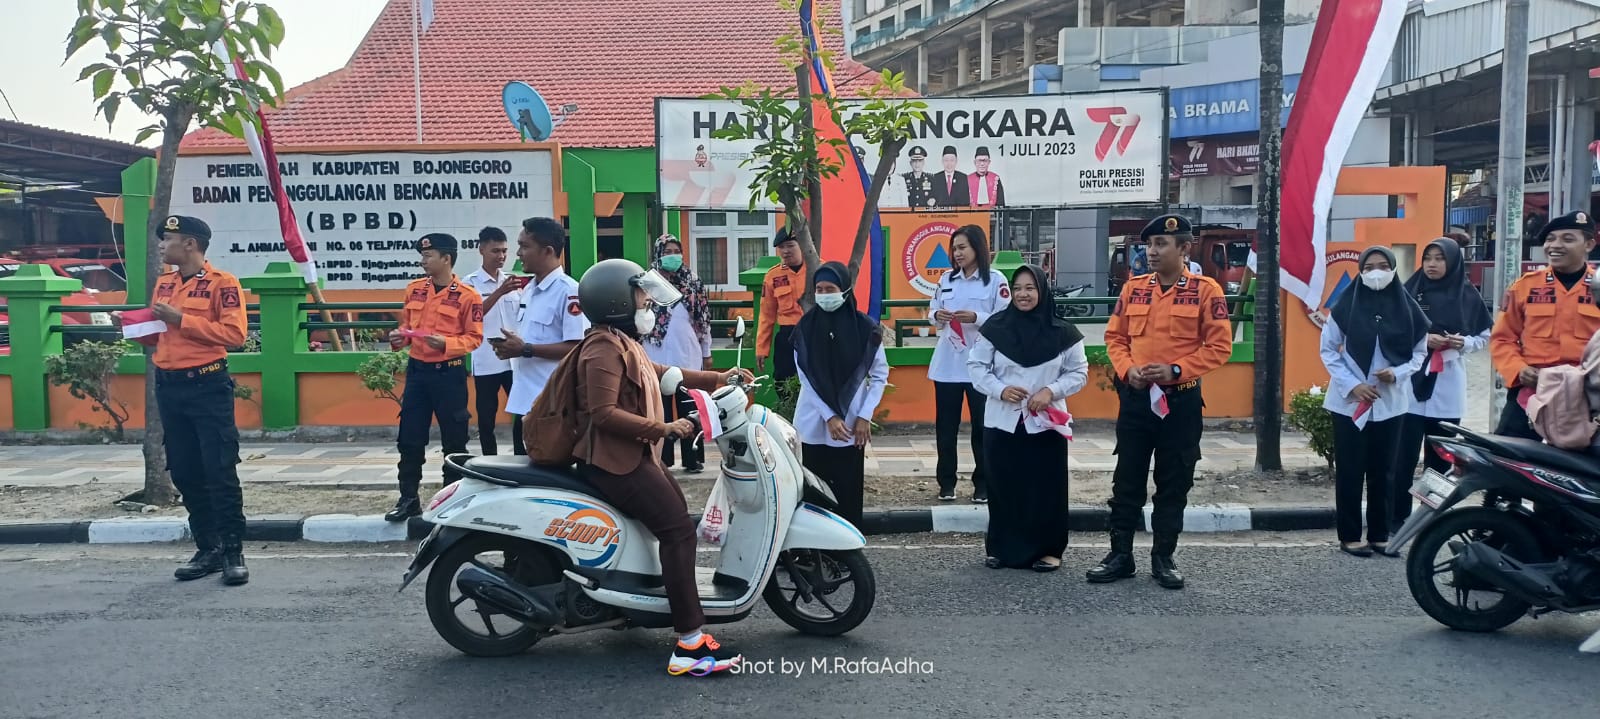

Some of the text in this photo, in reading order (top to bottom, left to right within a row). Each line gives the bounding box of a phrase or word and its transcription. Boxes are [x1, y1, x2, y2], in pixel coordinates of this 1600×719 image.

[1184, 98, 1250, 118] BRAMA
[998, 142, 1076, 157] 1 JULI 2023
[312, 161, 400, 176] KABUPATEN
[413, 159, 513, 175] BOJONEGORO
[1080, 168, 1145, 179] POLRI PRESISI
[1080, 178, 1145, 189] UNTUK NEGERI
[192, 181, 528, 203] BADAN PENNGGULANGAN BENCANA DAERAH
[229, 243, 245, 253] JL.
[326, 241, 346, 251] NO.
[349, 241, 363, 250] 06
[327, 272, 353, 281] BPBD
[543, 518, 622, 547] SCOOPY
